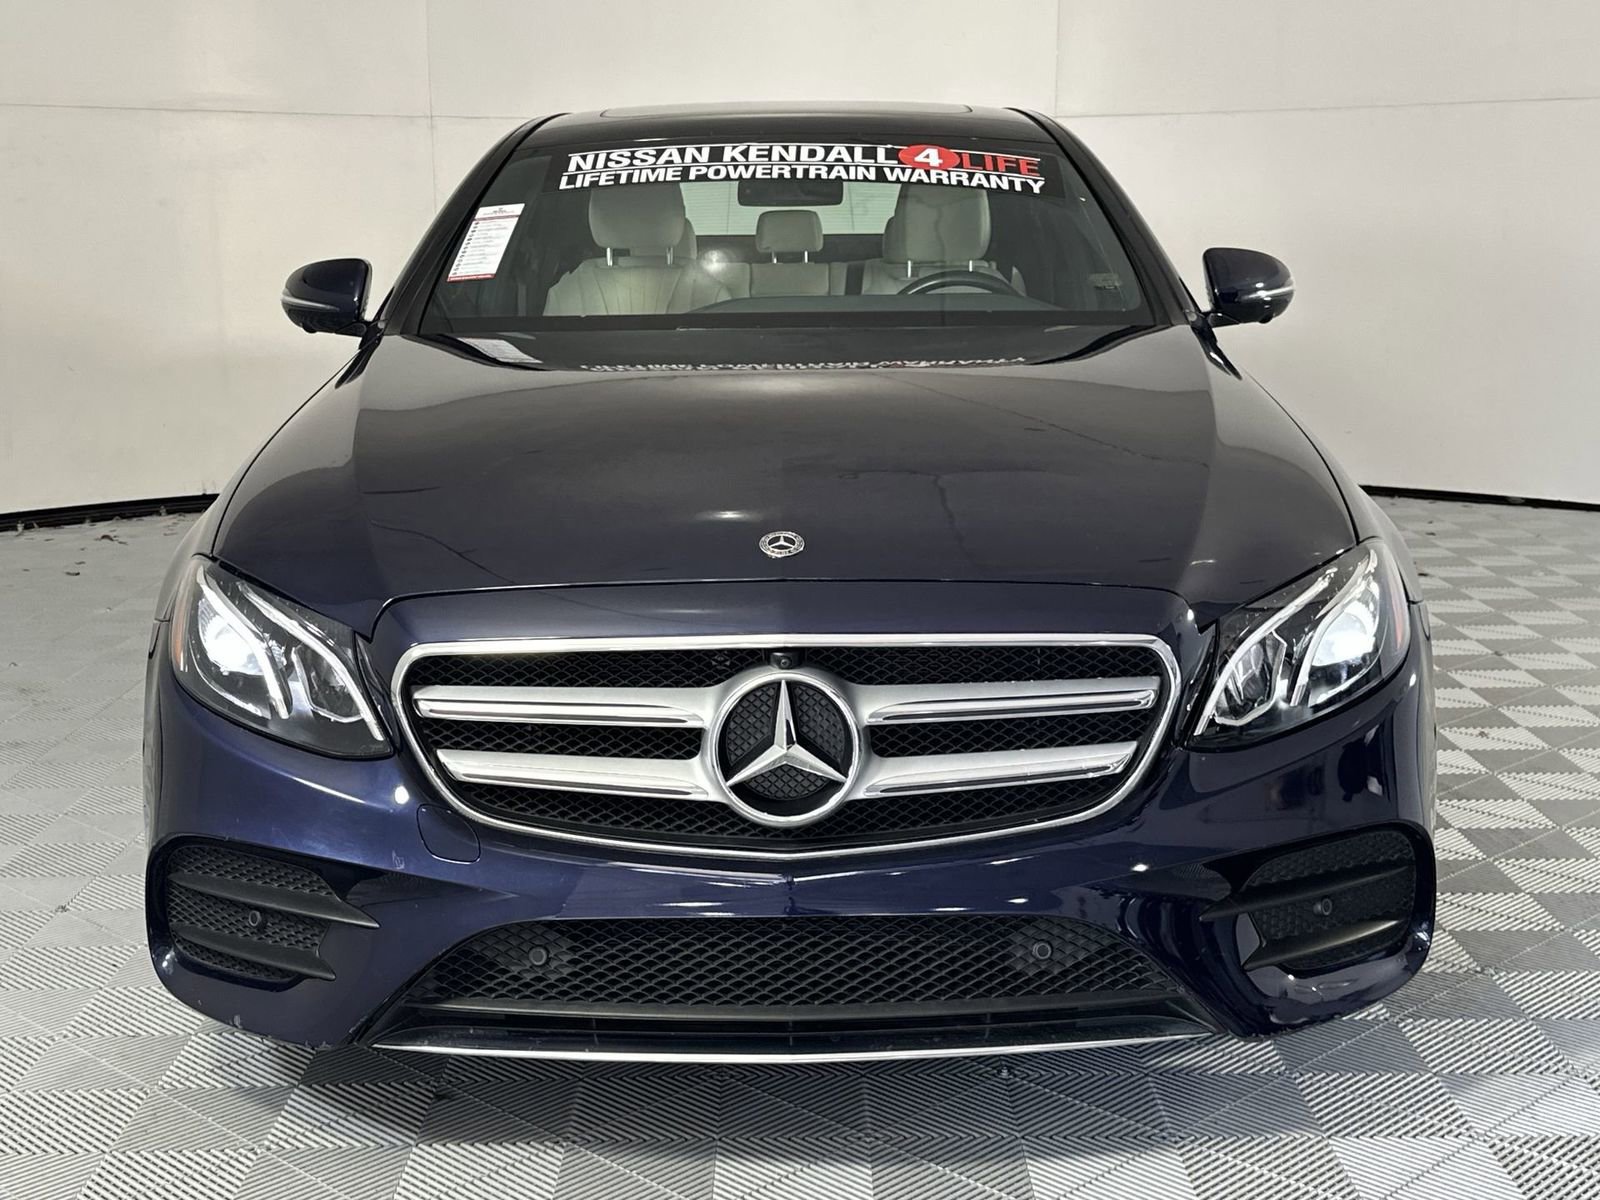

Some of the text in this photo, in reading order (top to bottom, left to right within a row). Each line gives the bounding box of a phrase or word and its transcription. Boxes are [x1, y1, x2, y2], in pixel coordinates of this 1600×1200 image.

[567, 145, 1040, 175] NISSAN KENDALL 4 LIFE
[558, 165, 1045, 194] LIFETIME POWERTRAIN WARRANTY
